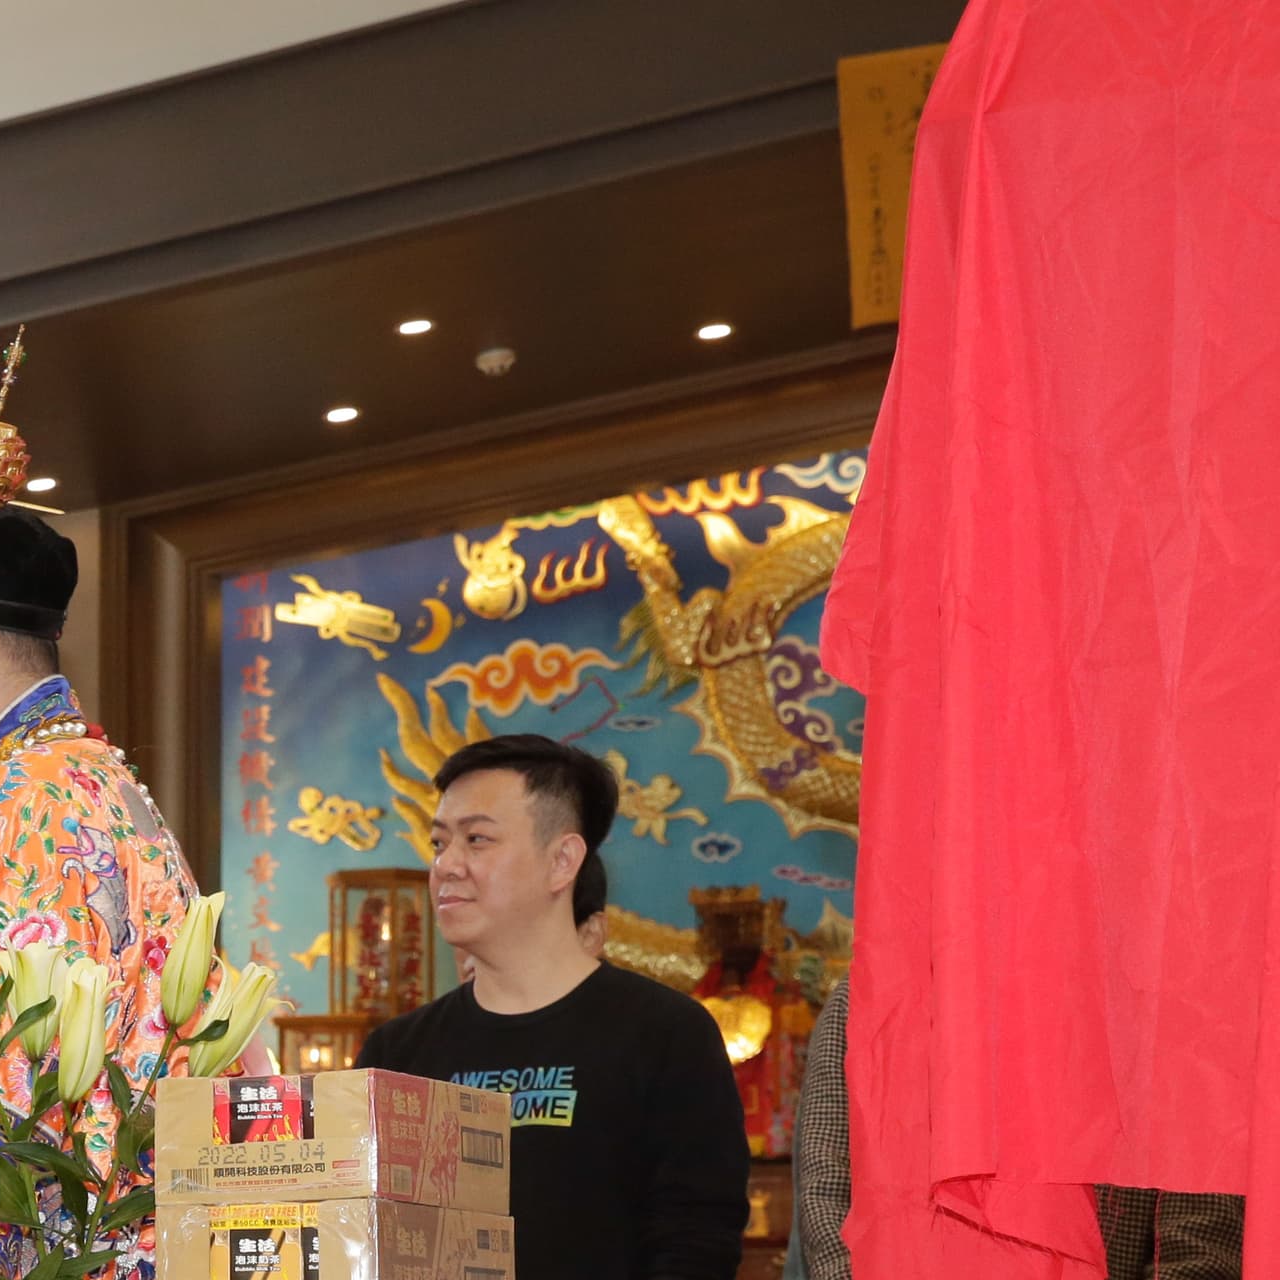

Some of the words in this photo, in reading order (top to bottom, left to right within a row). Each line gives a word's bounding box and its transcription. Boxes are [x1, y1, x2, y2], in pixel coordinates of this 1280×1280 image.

[450, 1066, 575, 1093] AWESOME
[240, 1086, 278, 1101] 生活
[512, 1095, 570, 1120] OME
[198, 1142, 326, 1166] 2022.05.04
[213, 1162, 326, 1179] 順開科技股份有限公司
[239, 1239, 276, 1253] 生活
